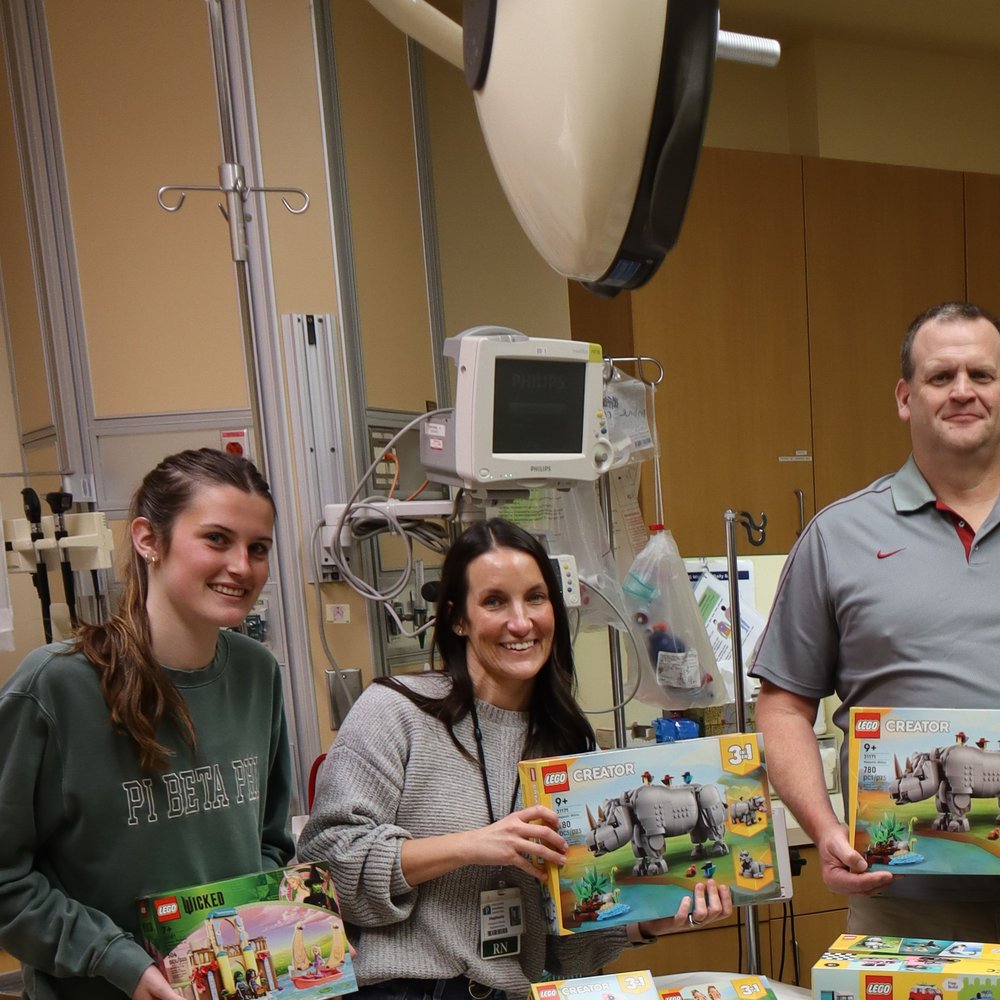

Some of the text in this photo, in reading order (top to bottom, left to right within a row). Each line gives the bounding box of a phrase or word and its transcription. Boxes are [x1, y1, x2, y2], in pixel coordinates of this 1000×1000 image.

[855, 720, 879, 732] LEGO
[885, 720, 950, 733] CREATOR
[863, 743, 877, 752] 9+
[572, 762, 636, 783] CREATOR
[863, 766, 877, 774] 780
[544, 772, 567, 787] LEGO
[121, 778, 158, 825] PI
[162, 764, 229, 819] BETA
[555, 797, 568, 807] 9+
[560, 820, 572, 830] 80
[158, 903, 178, 916] LEGO
[493, 941, 509, 955] RN
[540, 989, 557, 998] LEGO
[561, 983, 610, 995] CREATOR
[867, 982, 891, 995] LEGO
